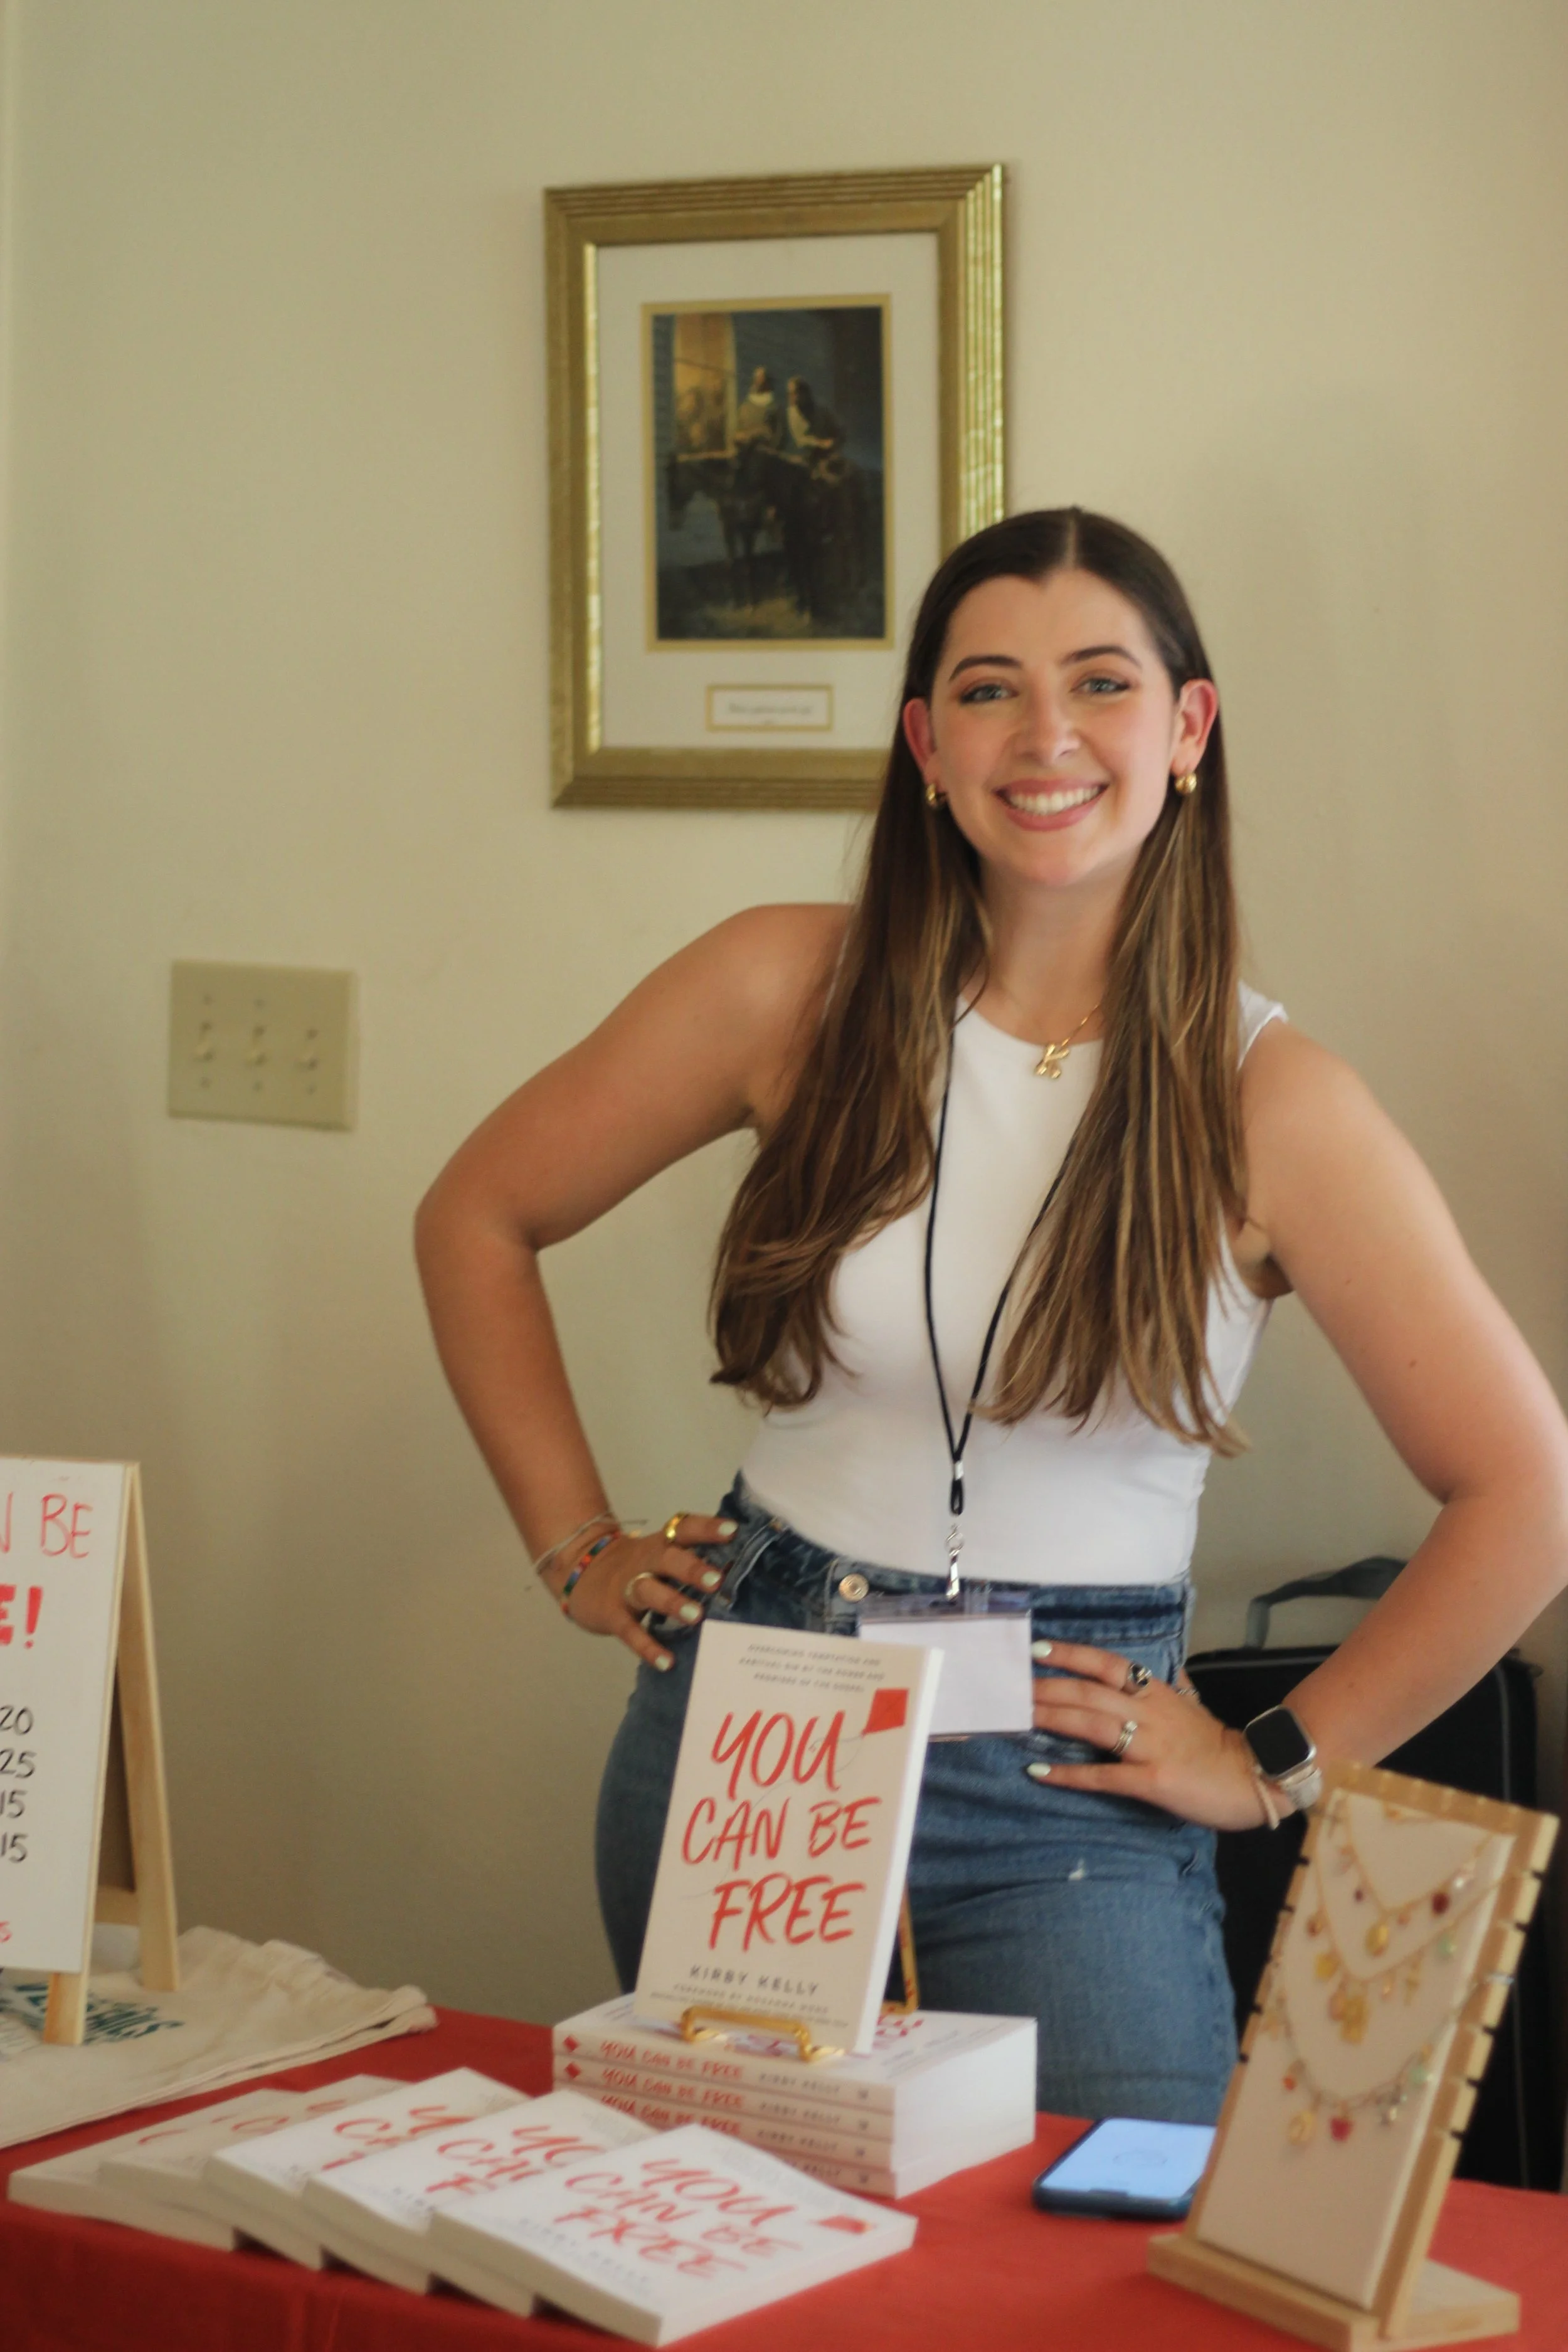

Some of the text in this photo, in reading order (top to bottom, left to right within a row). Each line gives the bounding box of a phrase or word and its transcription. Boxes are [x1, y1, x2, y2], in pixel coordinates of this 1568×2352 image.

[41, 1493, 93, 1559] BE
[712, 1710, 845, 1799] YOU
[682, 1798, 882, 1872] CAN BE
[709, 1873, 867, 1952] FREE
[691, 1965, 819, 1996] KIRBY KELLY
[601, 2040, 637, 2058] YOU
[642, 2050, 671, 2067] CAN
[677, 2057, 694, 2070] BE
[702, 2061, 744, 2079] FREE
[602, 2069, 638, 2087] YOU
[643, 2077, 672, 2095] CAN
[678, 2085, 694, 2099] BE
[702, 2089, 744, 2108] FREE
[640, 2104, 670, 2123] CAN
[565, 2172, 701, 2222] CAN
[642, 2158, 798, 2227] YOU
[553, 2206, 747, 2279] FREE
